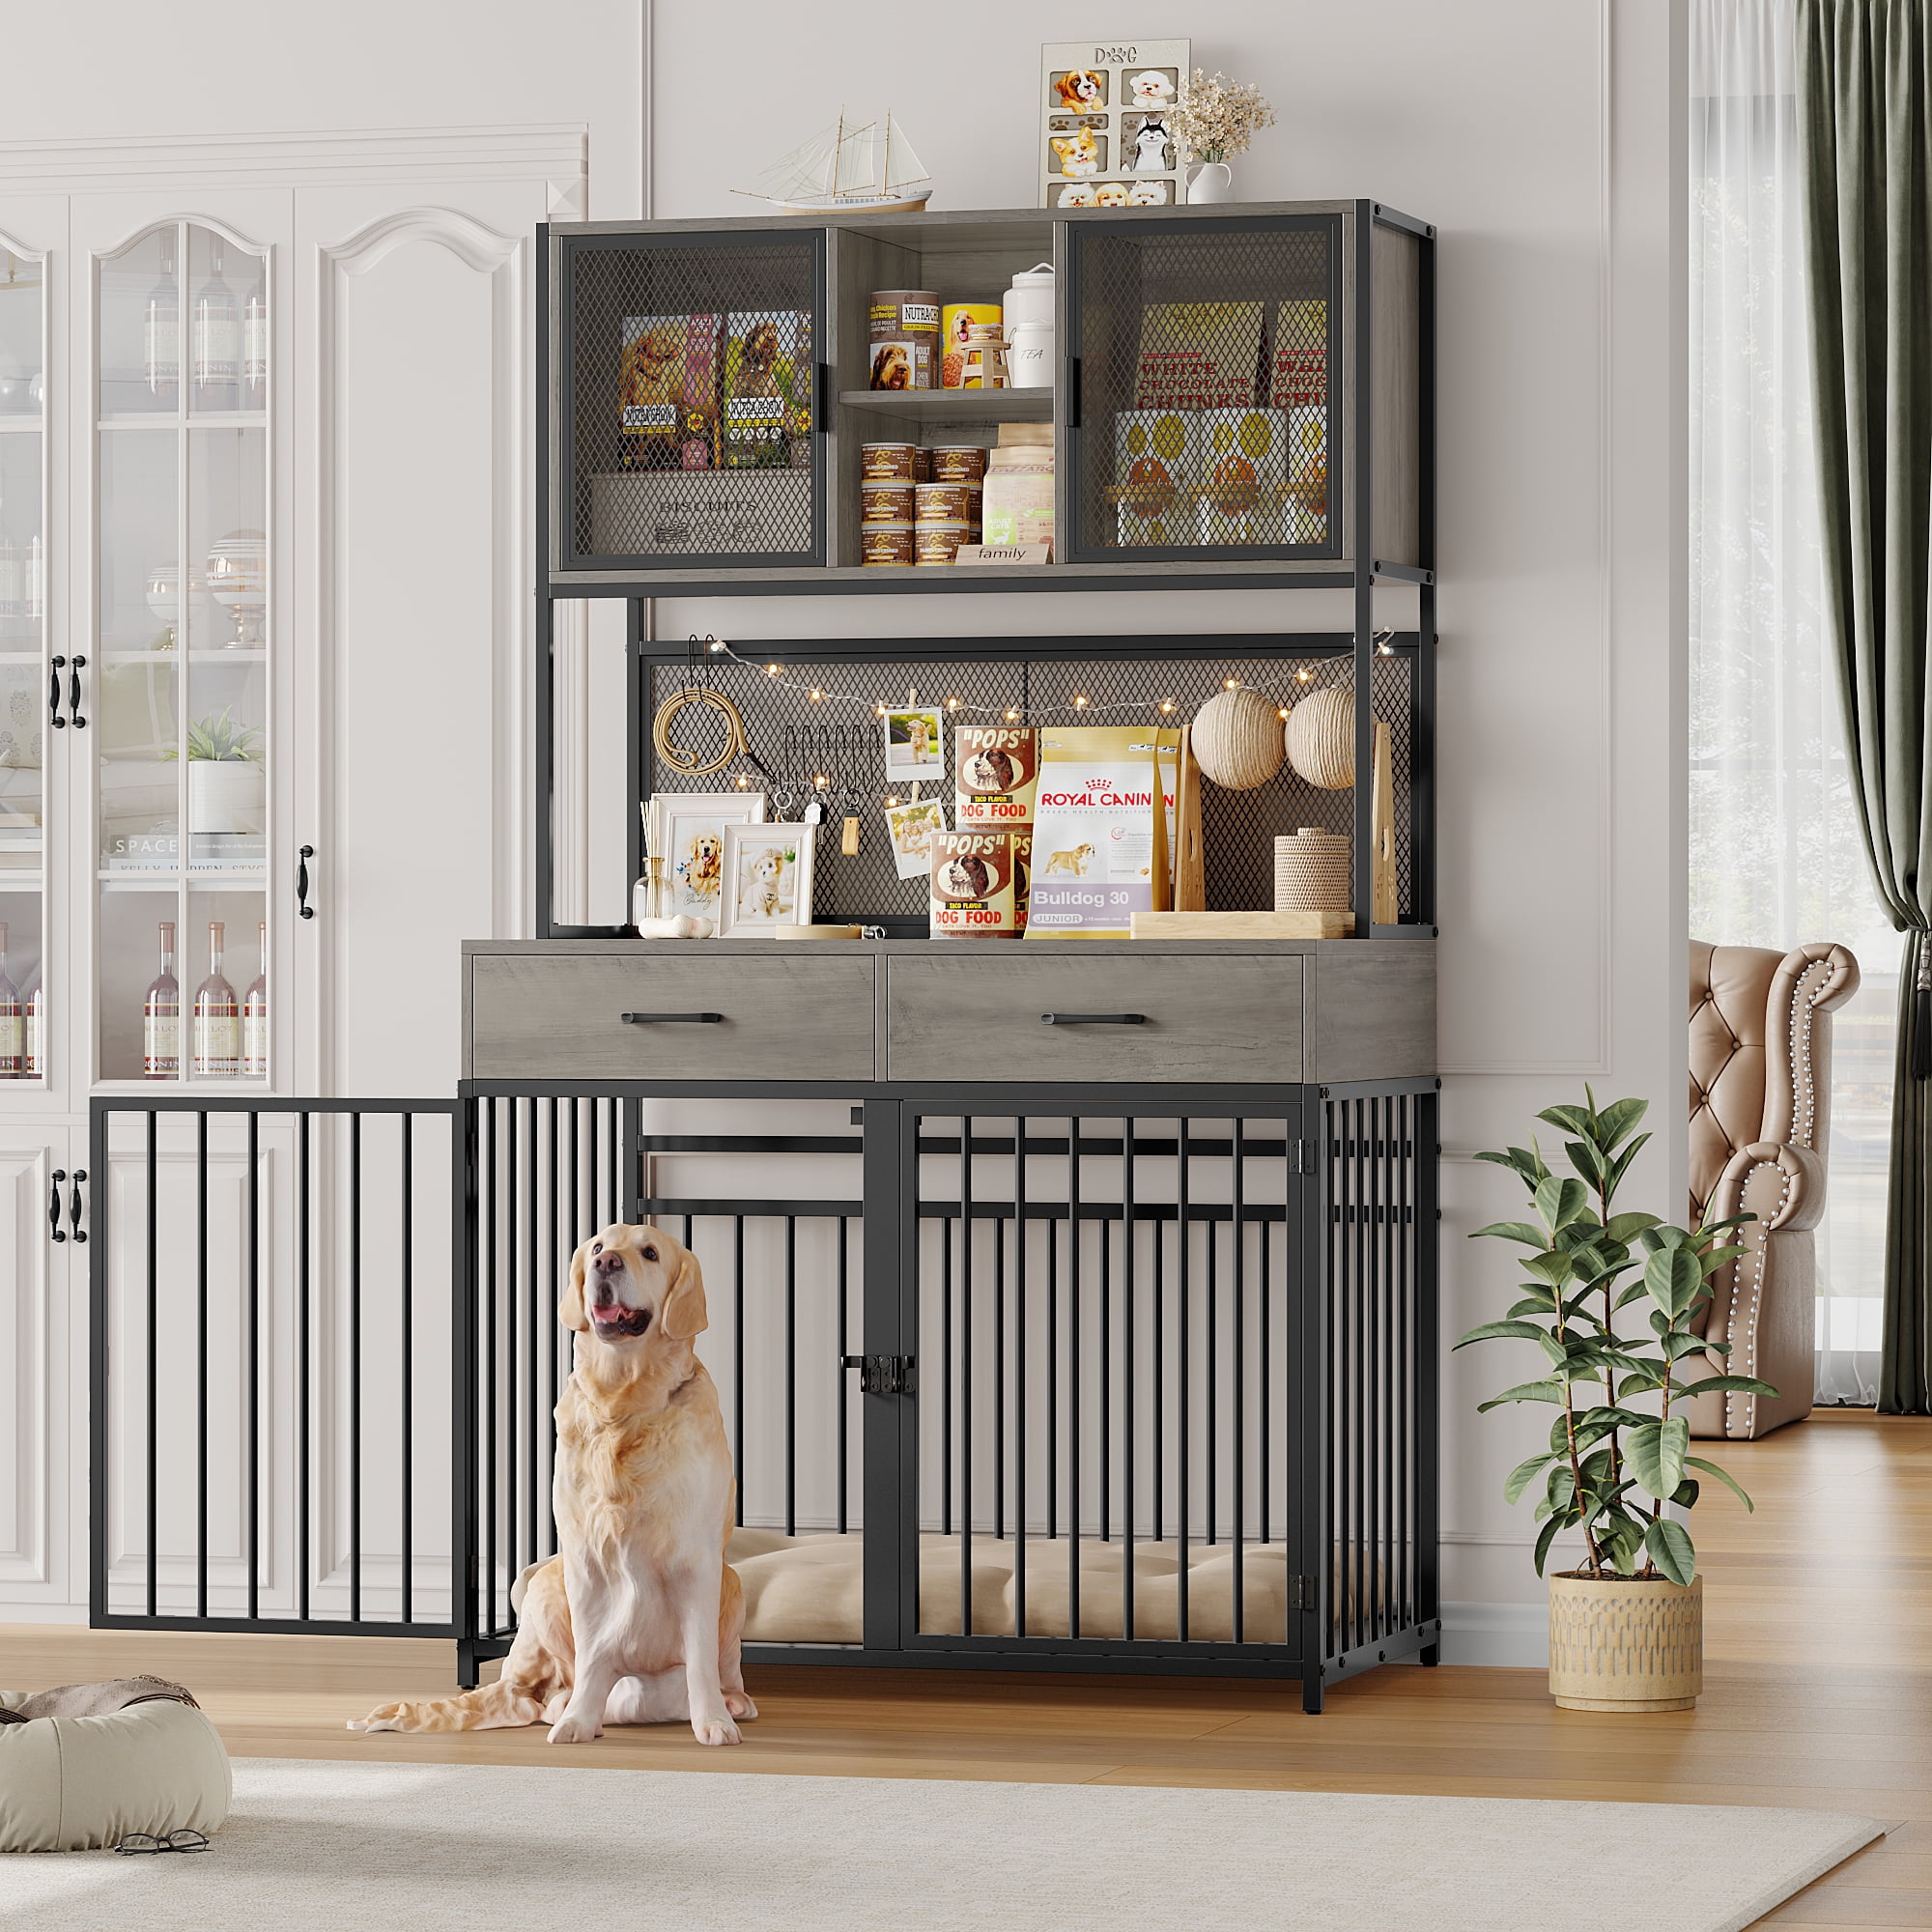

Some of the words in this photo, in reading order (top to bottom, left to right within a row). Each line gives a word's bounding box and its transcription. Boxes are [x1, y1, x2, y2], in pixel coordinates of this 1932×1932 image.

[1020, 349, 1043, 360] TEA
[1142, 362, 1218, 376] WHITE
[1139, 378, 1250, 391] CHOCOLATE
[660, 501, 756, 512] BISCUITS
[979, 548, 1026, 560] family
[1041, 793, 1095, 807] ROYAL
[1100, 792, 1151, 807] CANIN
[961, 804, 983, 817] DOG
[991, 804, 1027, 817] FOOD
[115, 839, 178, 852] SPACE
[1034, 891, 1105, 908] Bulldog
[1109, 891, 1129, 904] 30
[935, 911, 958, 924] DOG
[966, 911, 1002, 924] FOOD
[1014, 911, 1028, 924] DO
